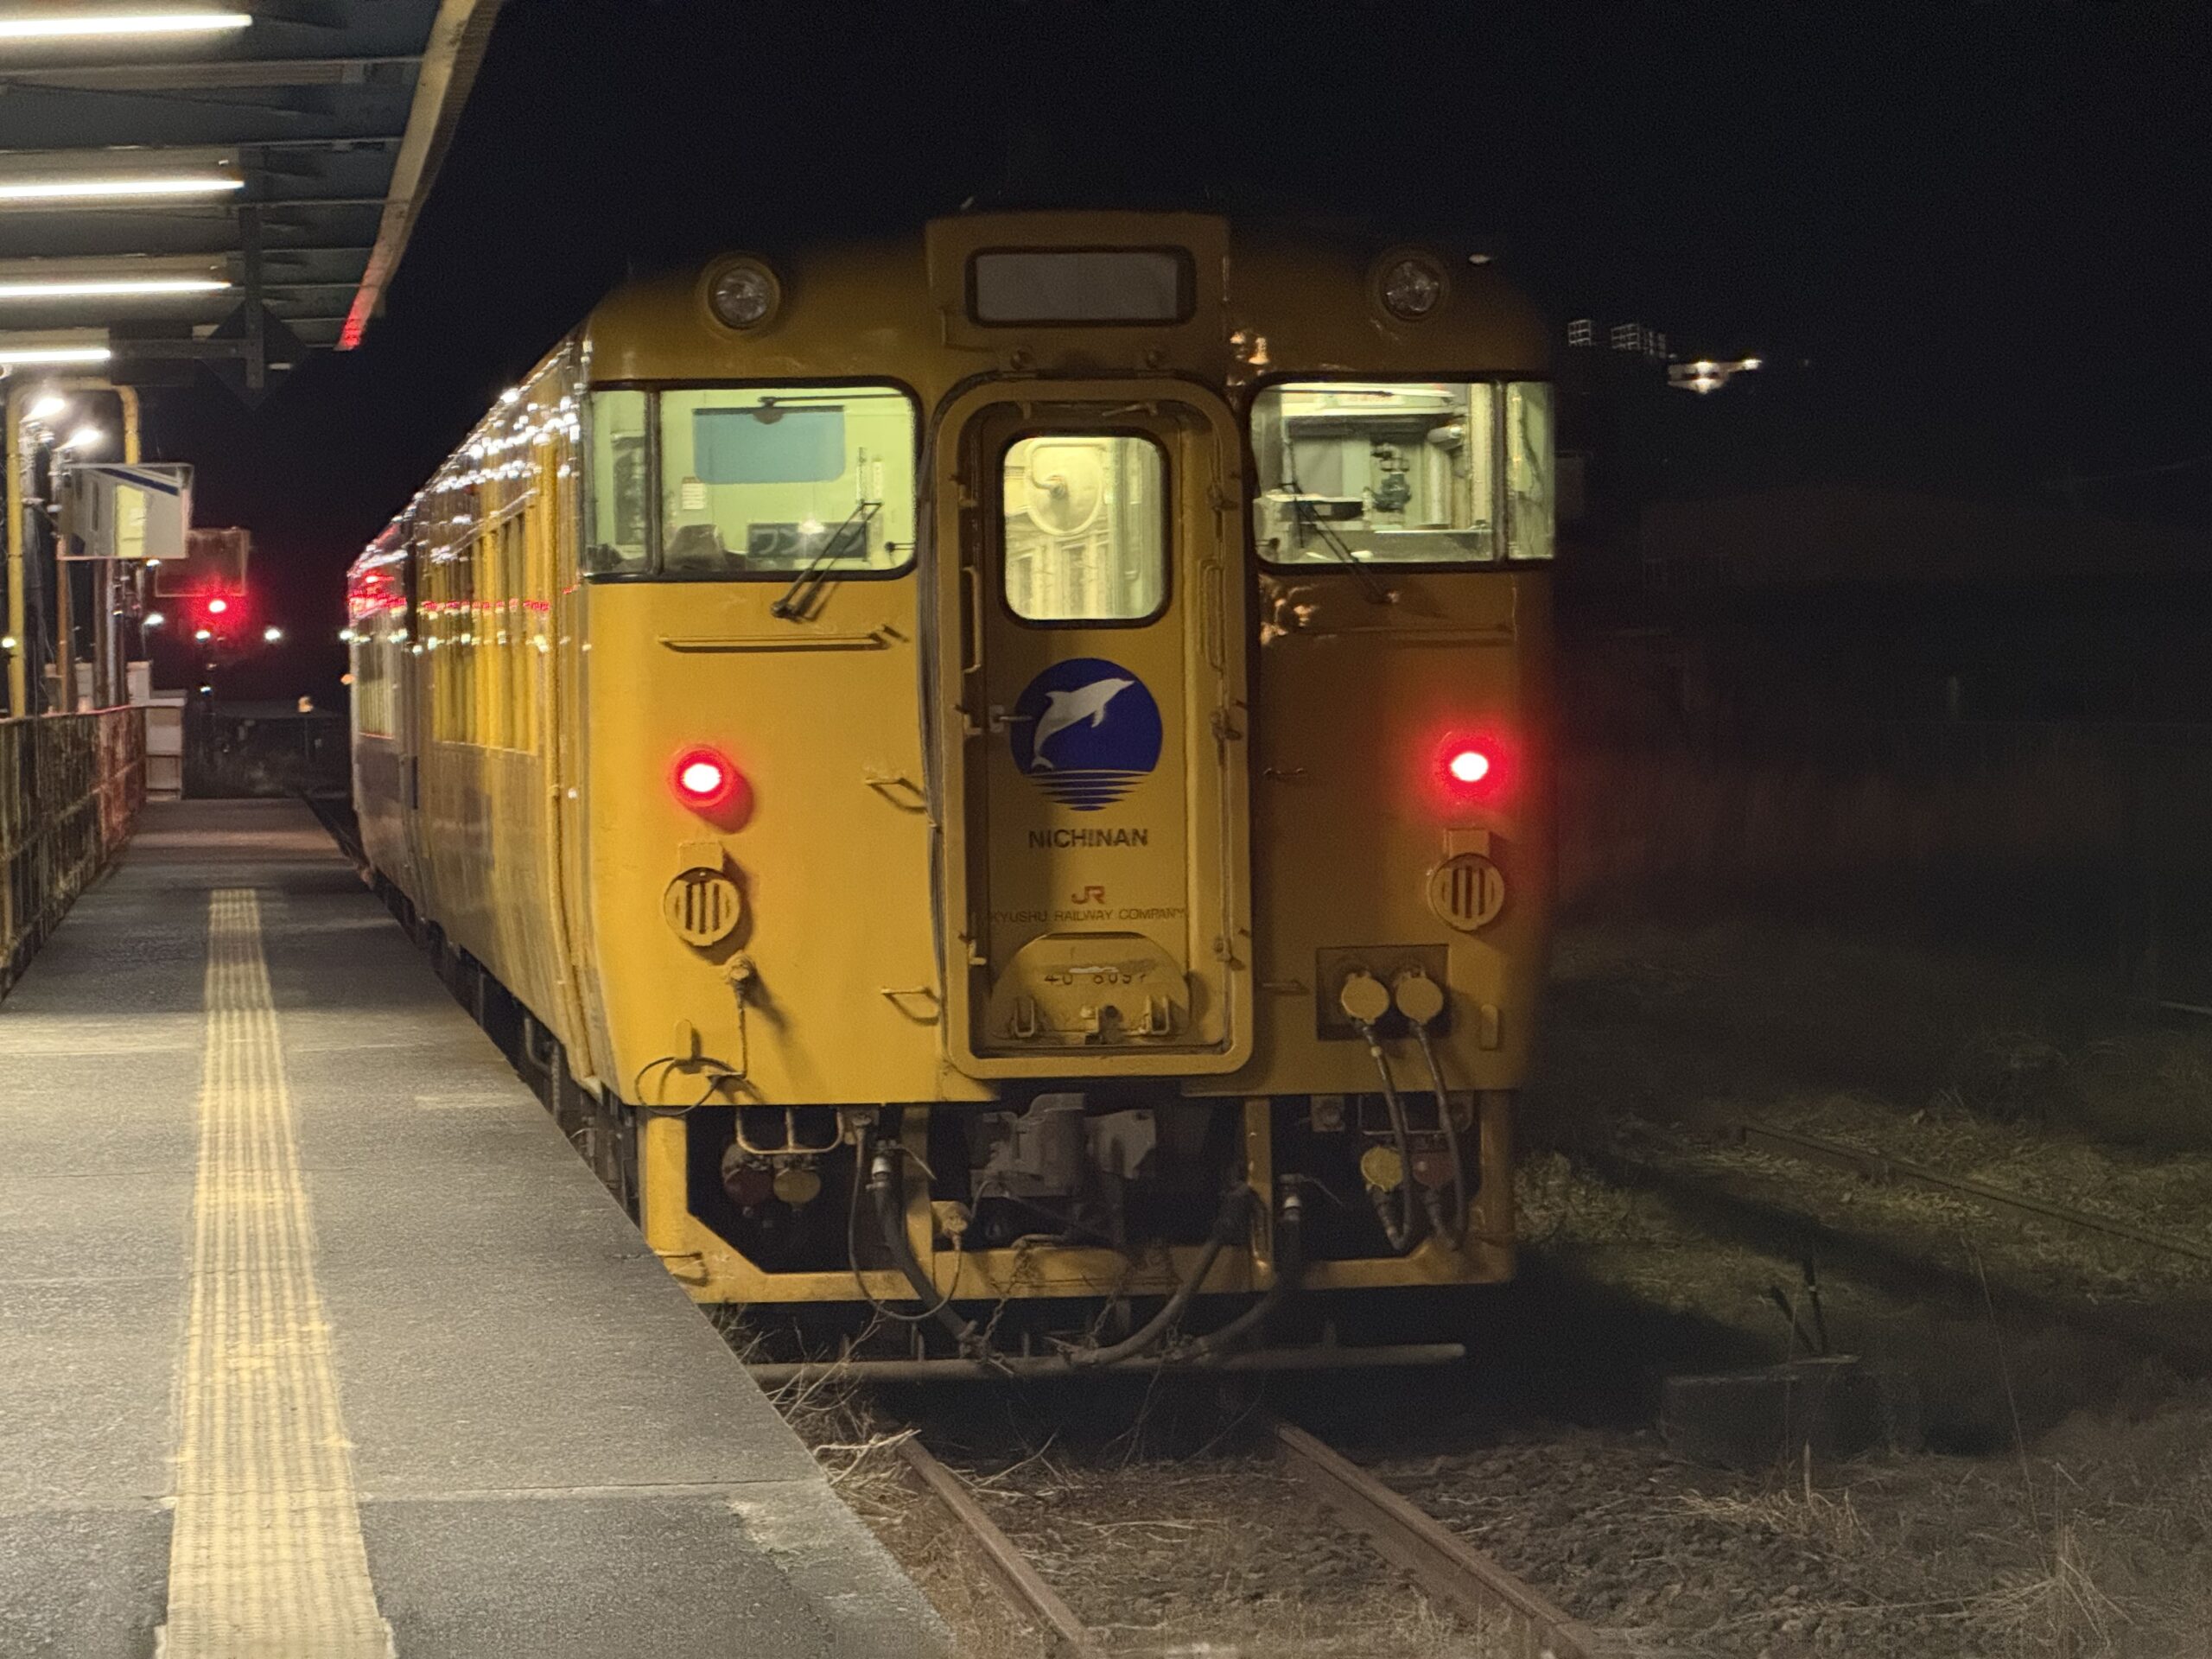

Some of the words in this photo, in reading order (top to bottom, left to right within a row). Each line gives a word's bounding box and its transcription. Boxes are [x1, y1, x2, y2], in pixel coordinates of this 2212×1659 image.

[1028, 828, 1148, 848] NICHINAN
[1071, 885, 1106, 905] JR
[991, 910, 1049, 923] KYUSHU
[1053, 909, 1113, 922] RAILWAY
[1118, 907, 1185, 921] COMPANY
